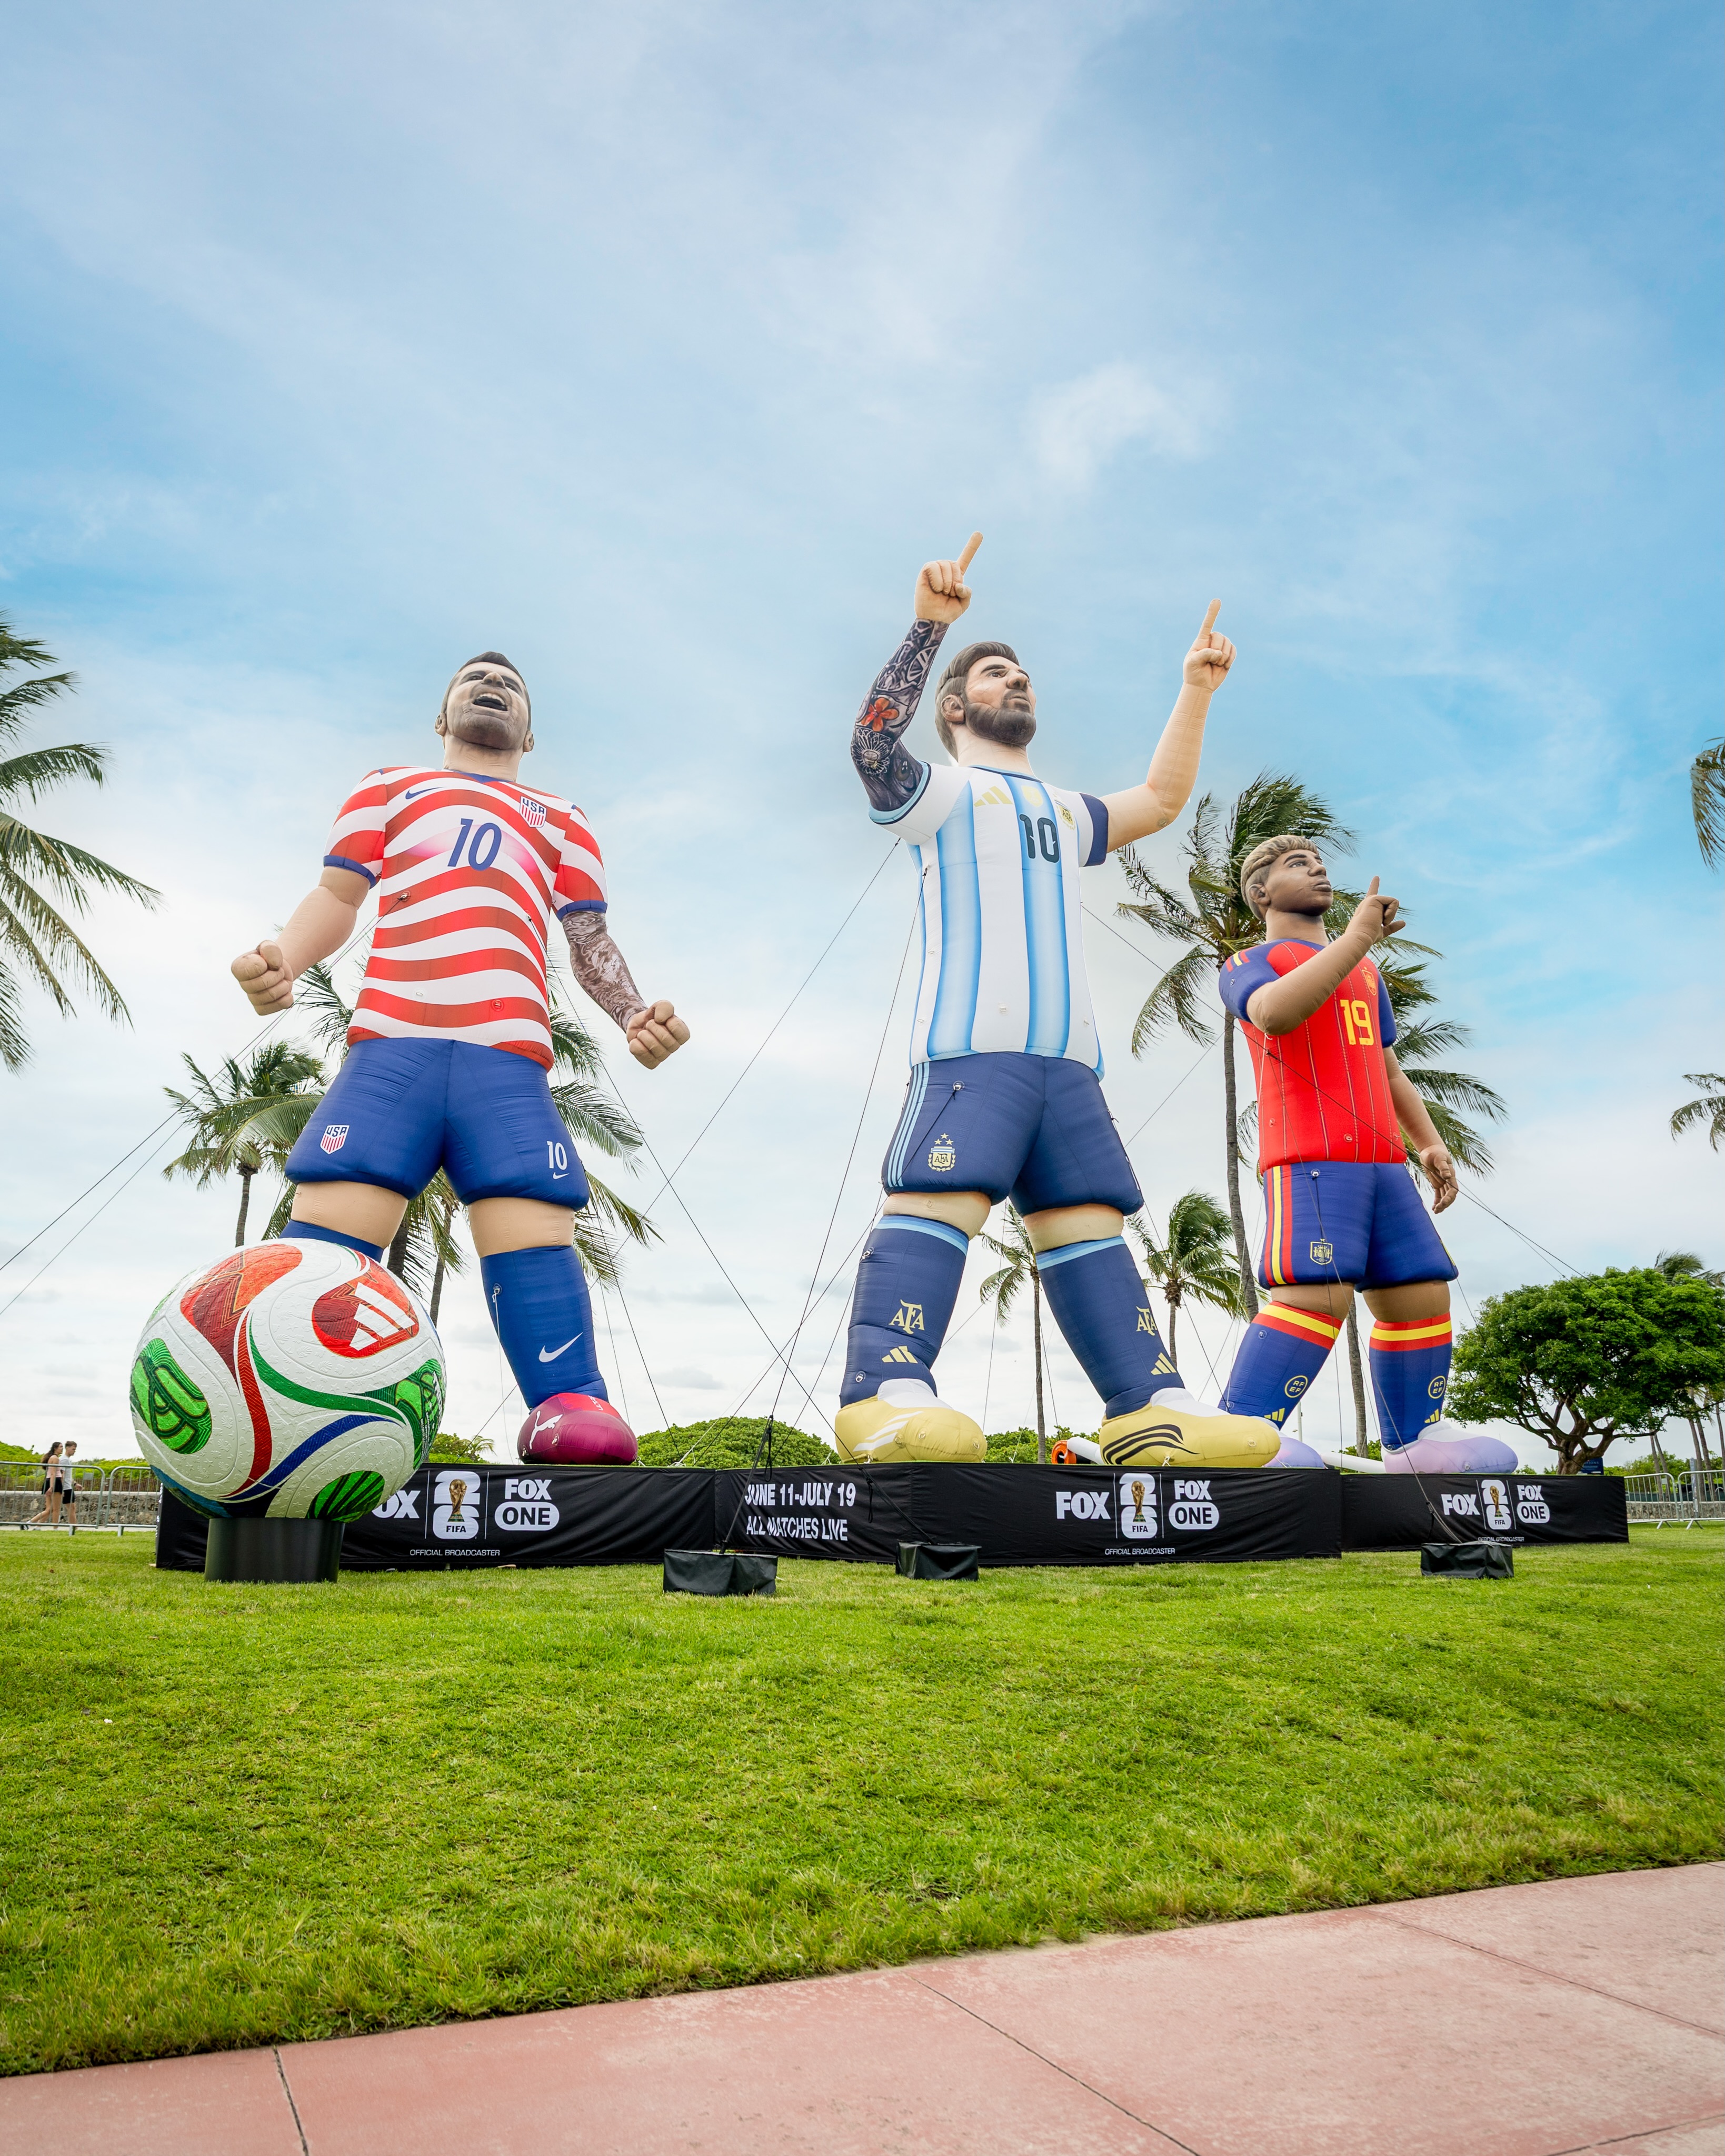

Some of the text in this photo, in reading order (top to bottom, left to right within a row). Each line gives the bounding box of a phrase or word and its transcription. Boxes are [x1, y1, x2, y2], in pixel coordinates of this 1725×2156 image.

[522, 798, 544, 814] USA
[447, 818, 502, 871] 10
[1019, 814, 1060, 863] 10
[1340, 999, 1374, 1046] 19
[326, 1126, 347, 1137] USA
[546, 1141, 567, 1170] 10
[934, 1153, 949, 1164] AFA
[888, 1299, 925, 1334] AFA
[1136, 1306, 1158, 1336] AFA
[504, 1479, 552, 1500] FOX
[744, 1484, 775, 1506] JUNE
[837, 1482, 856, 1506] 19
[1174, 1480, 1212, 1500] FOX
[1517, 1485, 1544, 1501] FOX
[372, 1490, 421, 1519] OX
[502, 1506, 551, 1525] ONE
[1056, 1491, 1111, 1520] FOX
[1175, 1506, 1213, 1525] ONE
[1441, 1494, 1481, 1515] FOX
[1521, 1505, 1547, 1519] ONE
[746, 1515, 848, 1541] ALL MATCHES LIVE
